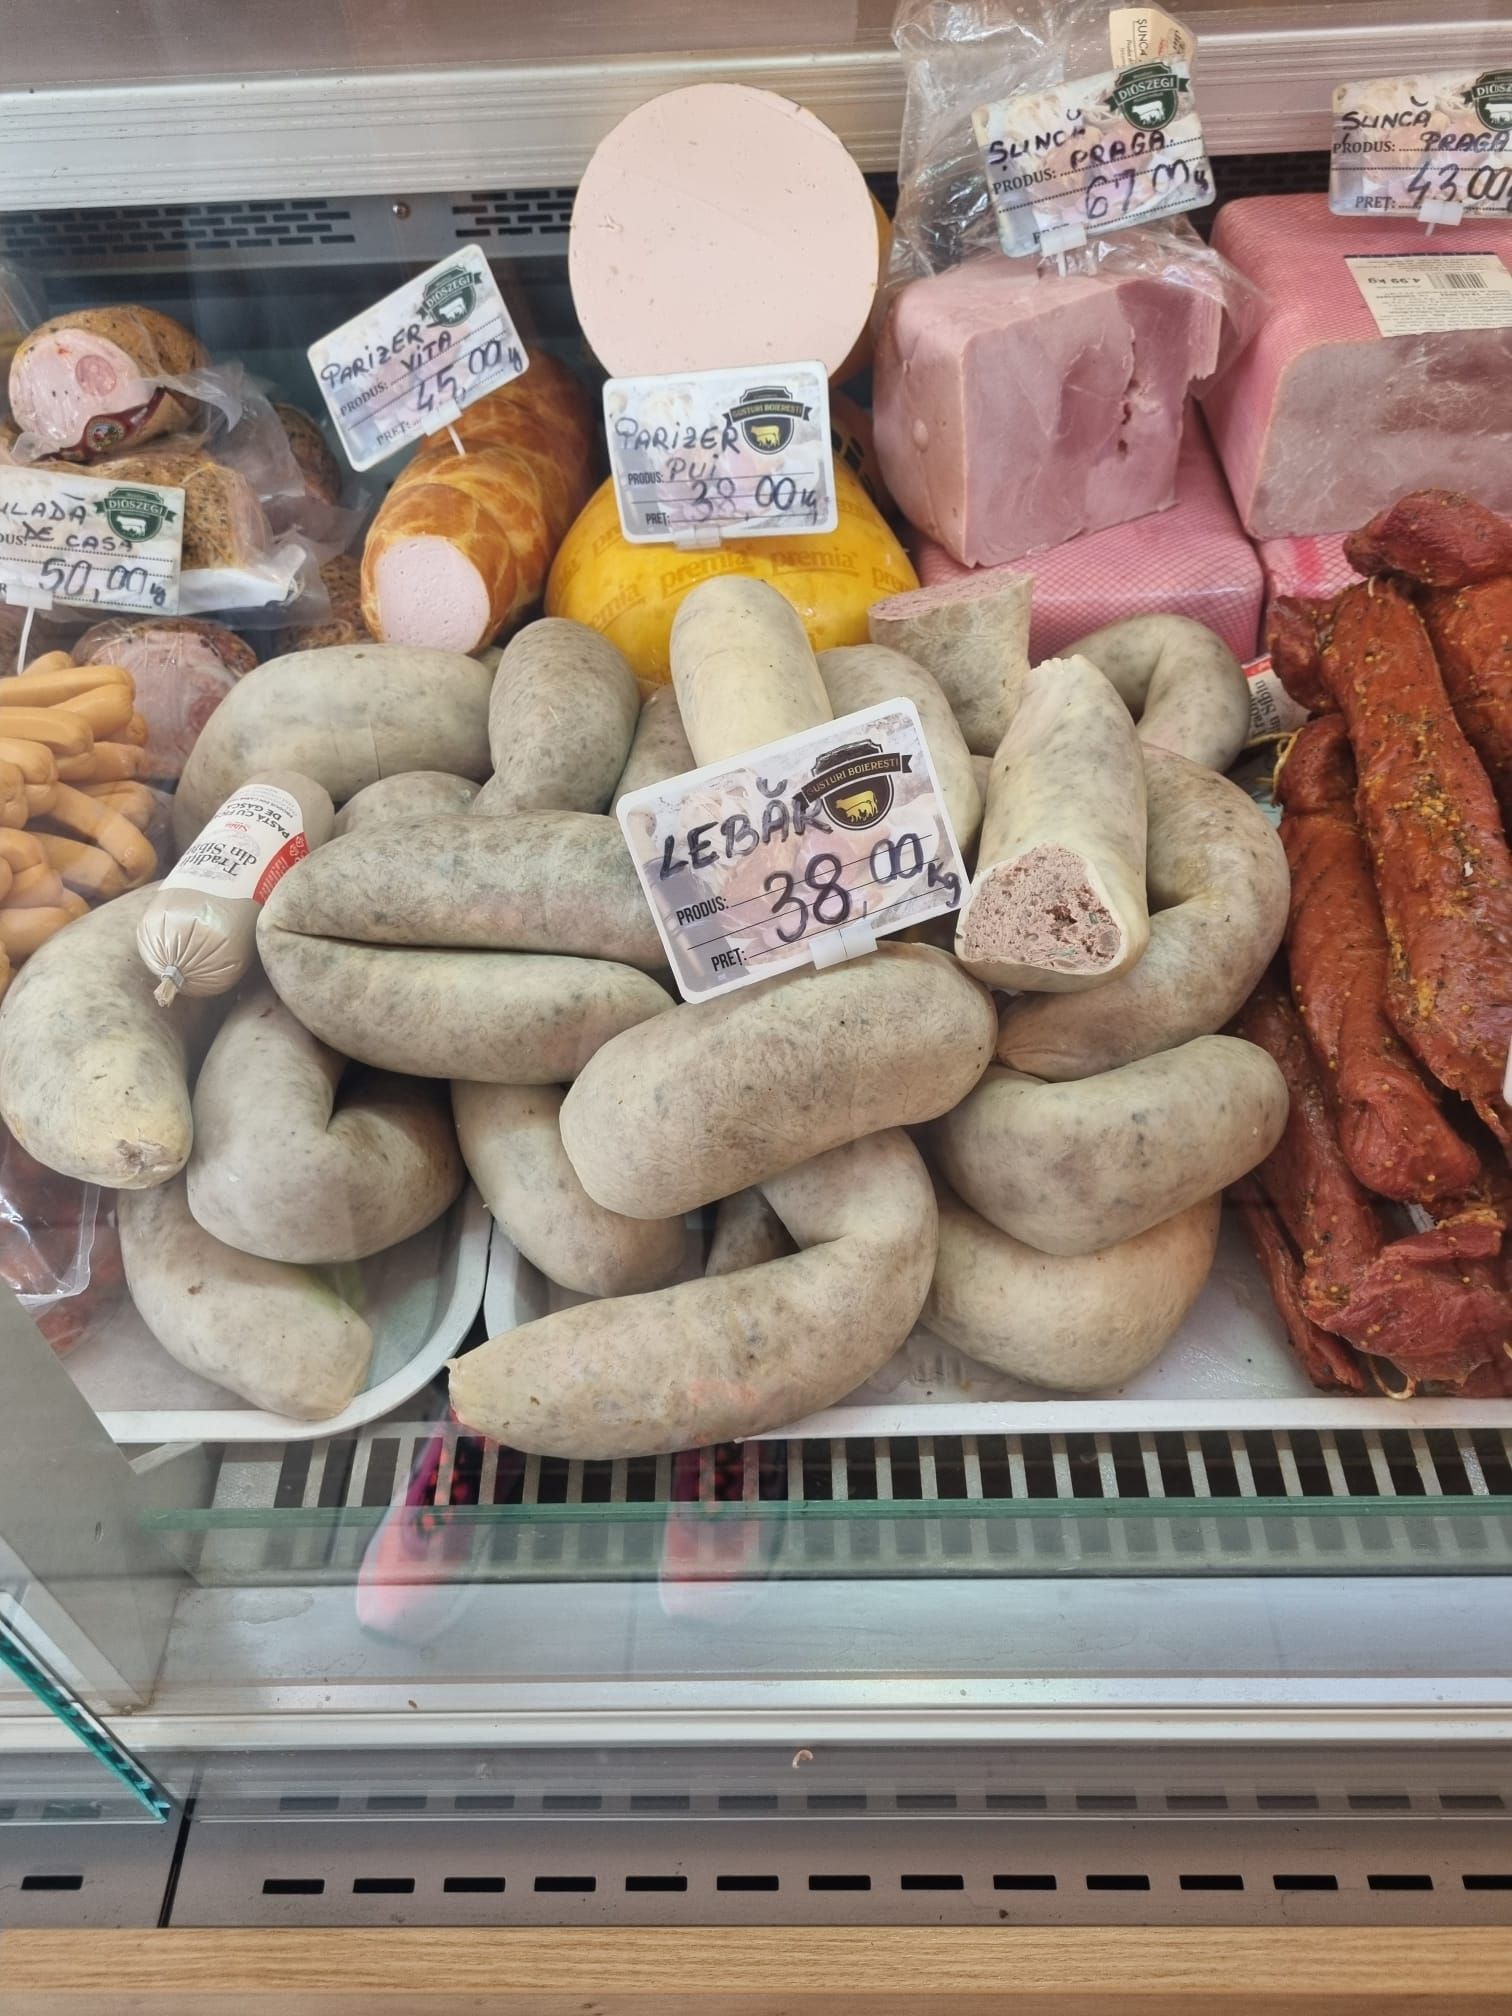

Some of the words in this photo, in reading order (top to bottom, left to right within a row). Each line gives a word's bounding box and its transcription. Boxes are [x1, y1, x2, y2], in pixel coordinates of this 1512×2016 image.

[1333, 141, 1396, 154] PRODUS:
[1420, 130, 1510, 152] PRAGA
[992, 168, 1057, 195] PRODUS:
[340, 382, 388, 417] PRODUS:
[628, 471, 664, 485] PRODUS:
[22, 521, 55, 542] DE
[238, 809, 254, 817] CU
[265, 809, 282, 821] DE
[230, 846, 257, 866] din
[676, 897, 730, 926] PRODUS:
